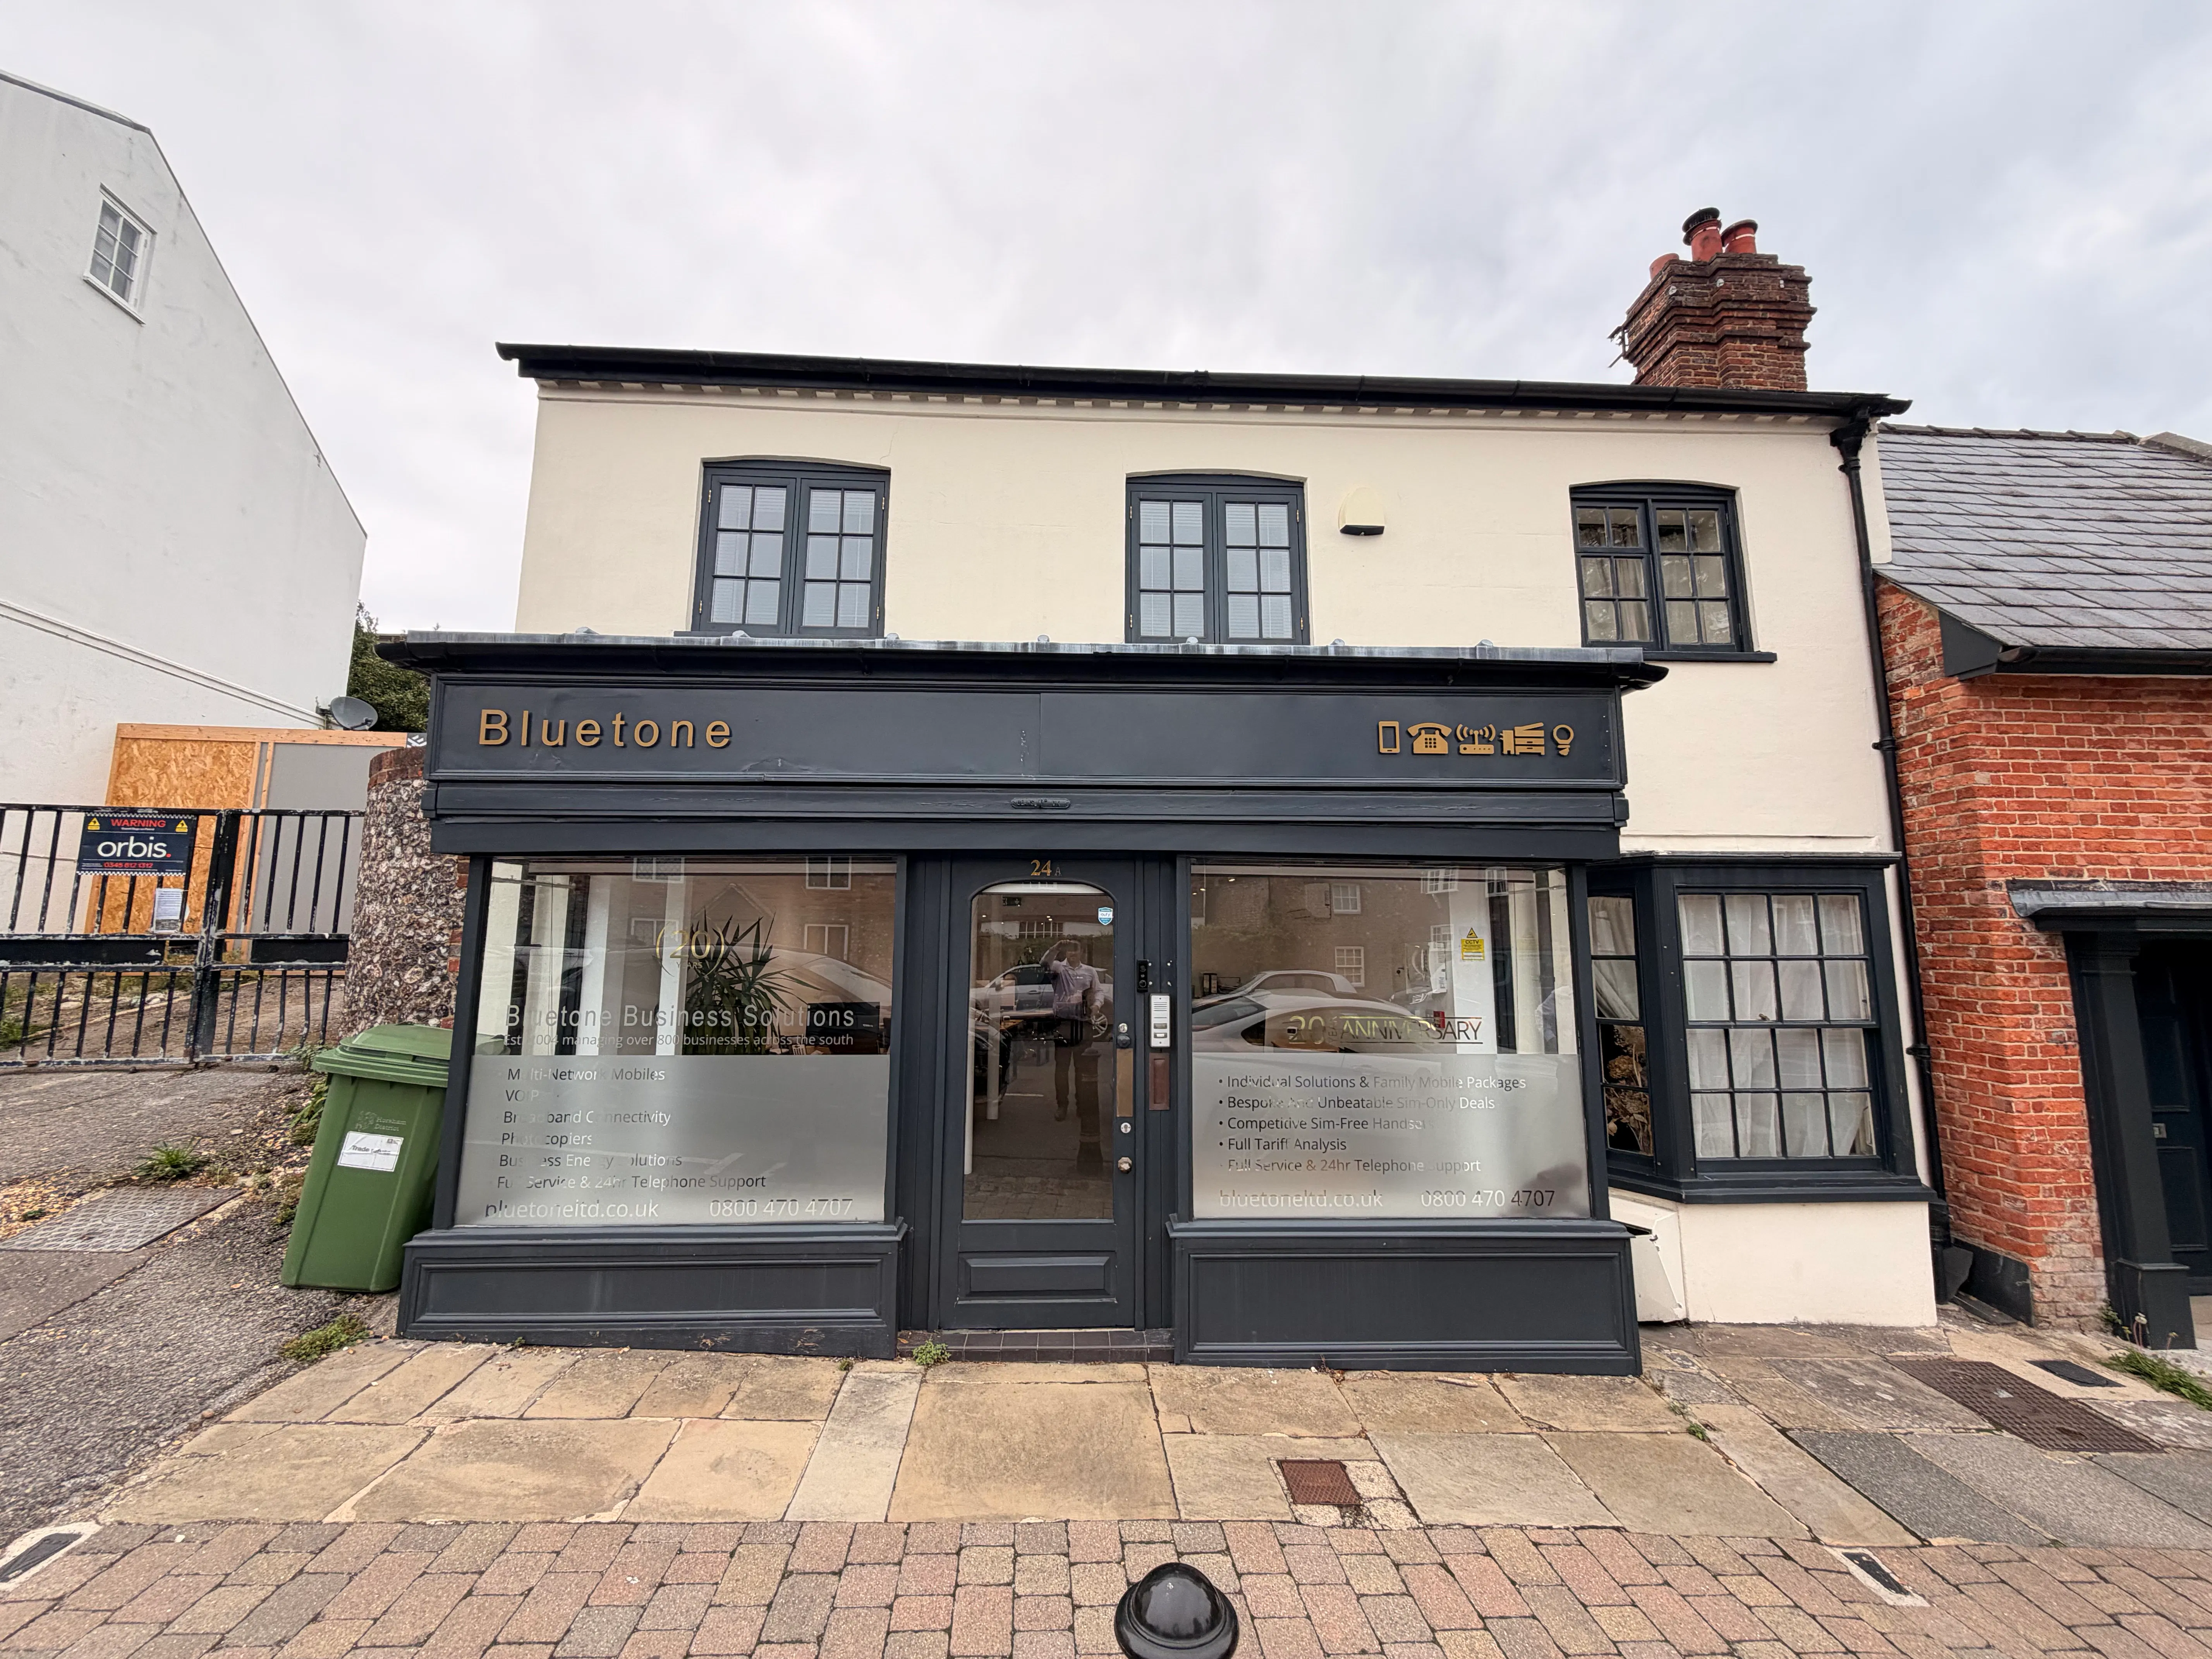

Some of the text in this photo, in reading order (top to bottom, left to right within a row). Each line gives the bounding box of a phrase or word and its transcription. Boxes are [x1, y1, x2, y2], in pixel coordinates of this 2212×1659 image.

[478, 709, 732, 749] Bluetone
[110, 819, 166, 828] WARNING
[97, 836, 172, 858] orbis.
[506, 1005, 854, 1027] Buetone Business Solutions
[1329, 1015, 1337, 1045] YEA
[1340, 1020, 1482, 1040] ANNIVERSARY
[528, 1034, 558, 1045] 004
[563, 1036, 623, 1048] managing
[627, 1037, 654, 1045] over
[658, 1034, 679, 1046] 800
[684, 1034, 750, 1045] businesses
[754, 1036, 792, 1045] across
[796, 1034, 816, 1045] the
[819, 1034, 853, 1045] south
[508, 1067, 665, 1080] Mlti-Network Mobiles
[1228, 1075, 1526, 1091] Individual Solutions & Family Mobile Packages
[505, 1089, 539, 1102] VOIP
[1228, 1096, 1284, 1111] Bespoke
[1318, 1096, 1393, 1109] Unbeatable
[1397, 1096, 1456, 1112] Sim-Only
[1460, 1096, 1495, 1109] Deals
[504, 1110, 671, 1126] Bradband Cnnectivity
[1228, 1117, 1433, 1132] Competitive Sim-Free Handset
[1229, 1138, 1347, 1153] Full Tariff Analysis
[500, 1153, 682, 1170] Busess Eney olutions
[1229, 1159, 1481, 1175] Full Service & 24hr Telephone upport
[498, 1175, 766, 1191] Fu Service & 24hr Telephone Support
[1220, 1189, 1555, 1207] bluetoneltd.co.uk 0800 470 4707
[710, 1199, 757, 1216] 0800
[763, 1199, 799, 1216] 470
[805, 1199, 853, 1216] 4707
